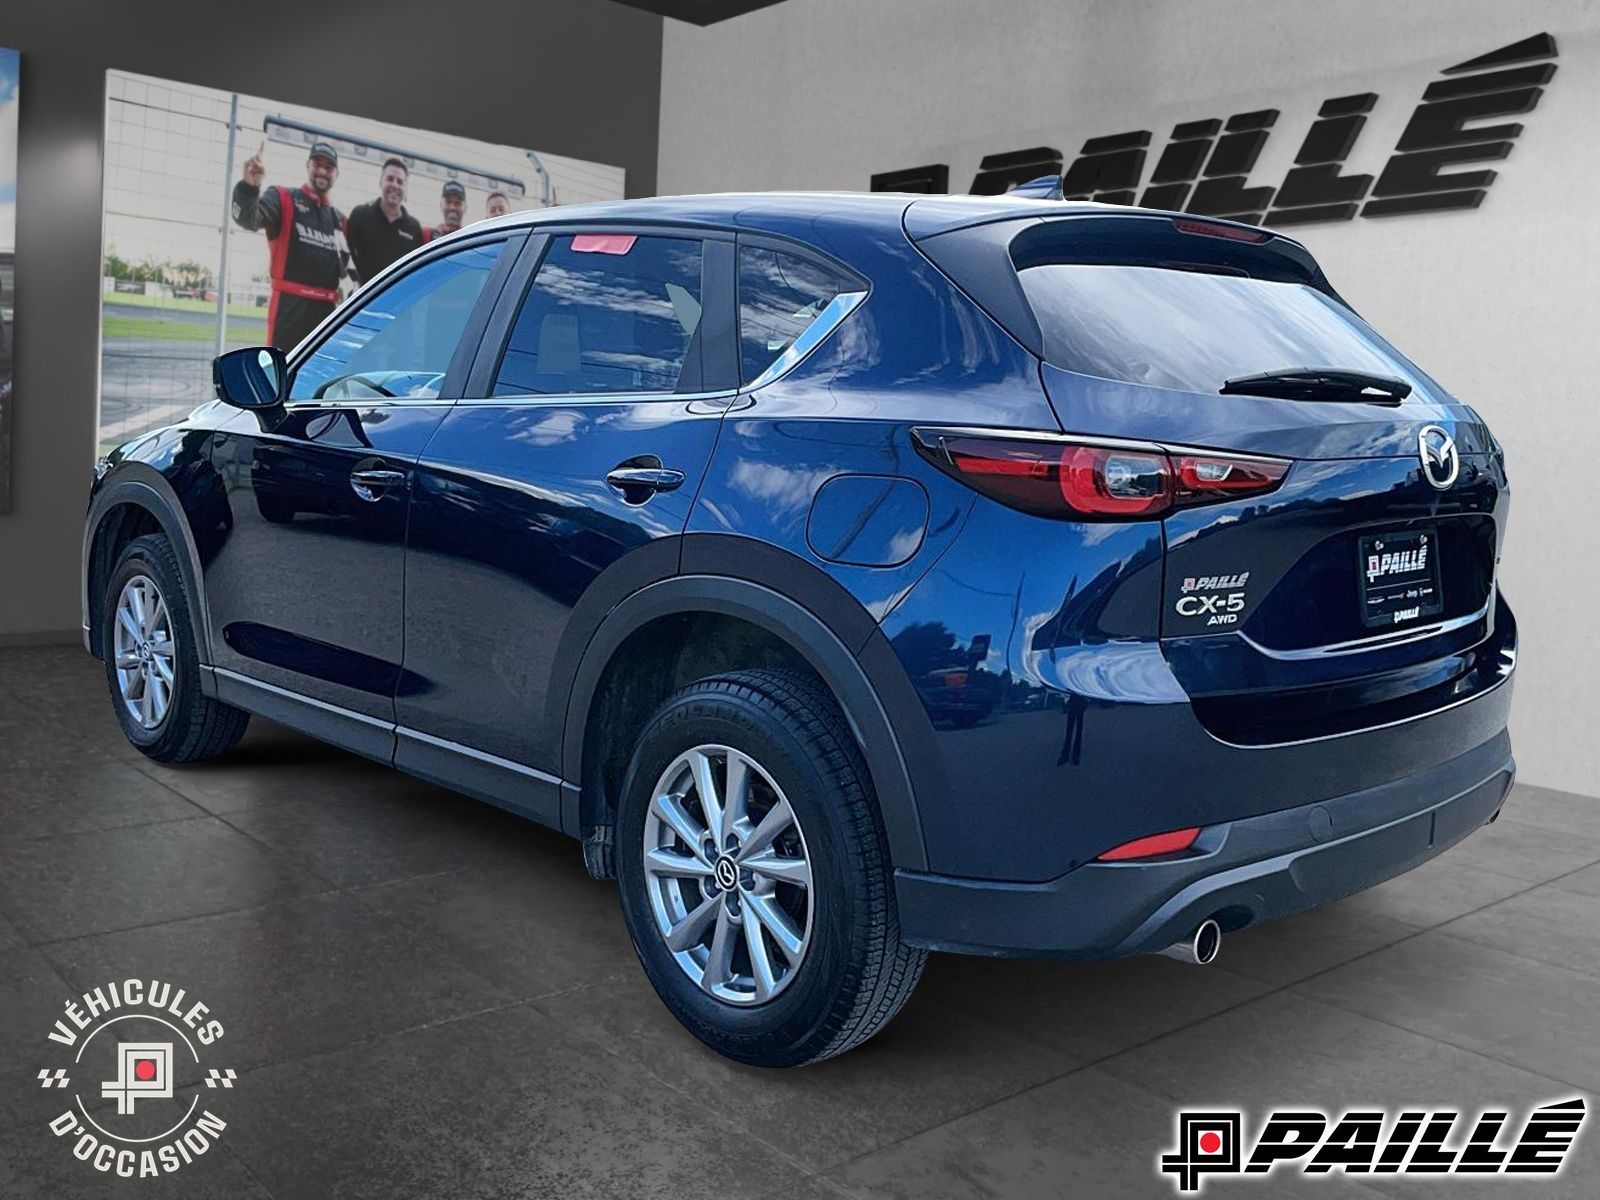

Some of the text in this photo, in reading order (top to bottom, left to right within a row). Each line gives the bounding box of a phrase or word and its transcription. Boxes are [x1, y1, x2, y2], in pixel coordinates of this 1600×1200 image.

[1381, 544, 1427, 575] PAILLÉ
[1195, 571, 1250, 590] PAILLÉ
[1175, 592, 1245, 616] CX-5
[1206, 613, 1237, 626] AWD
